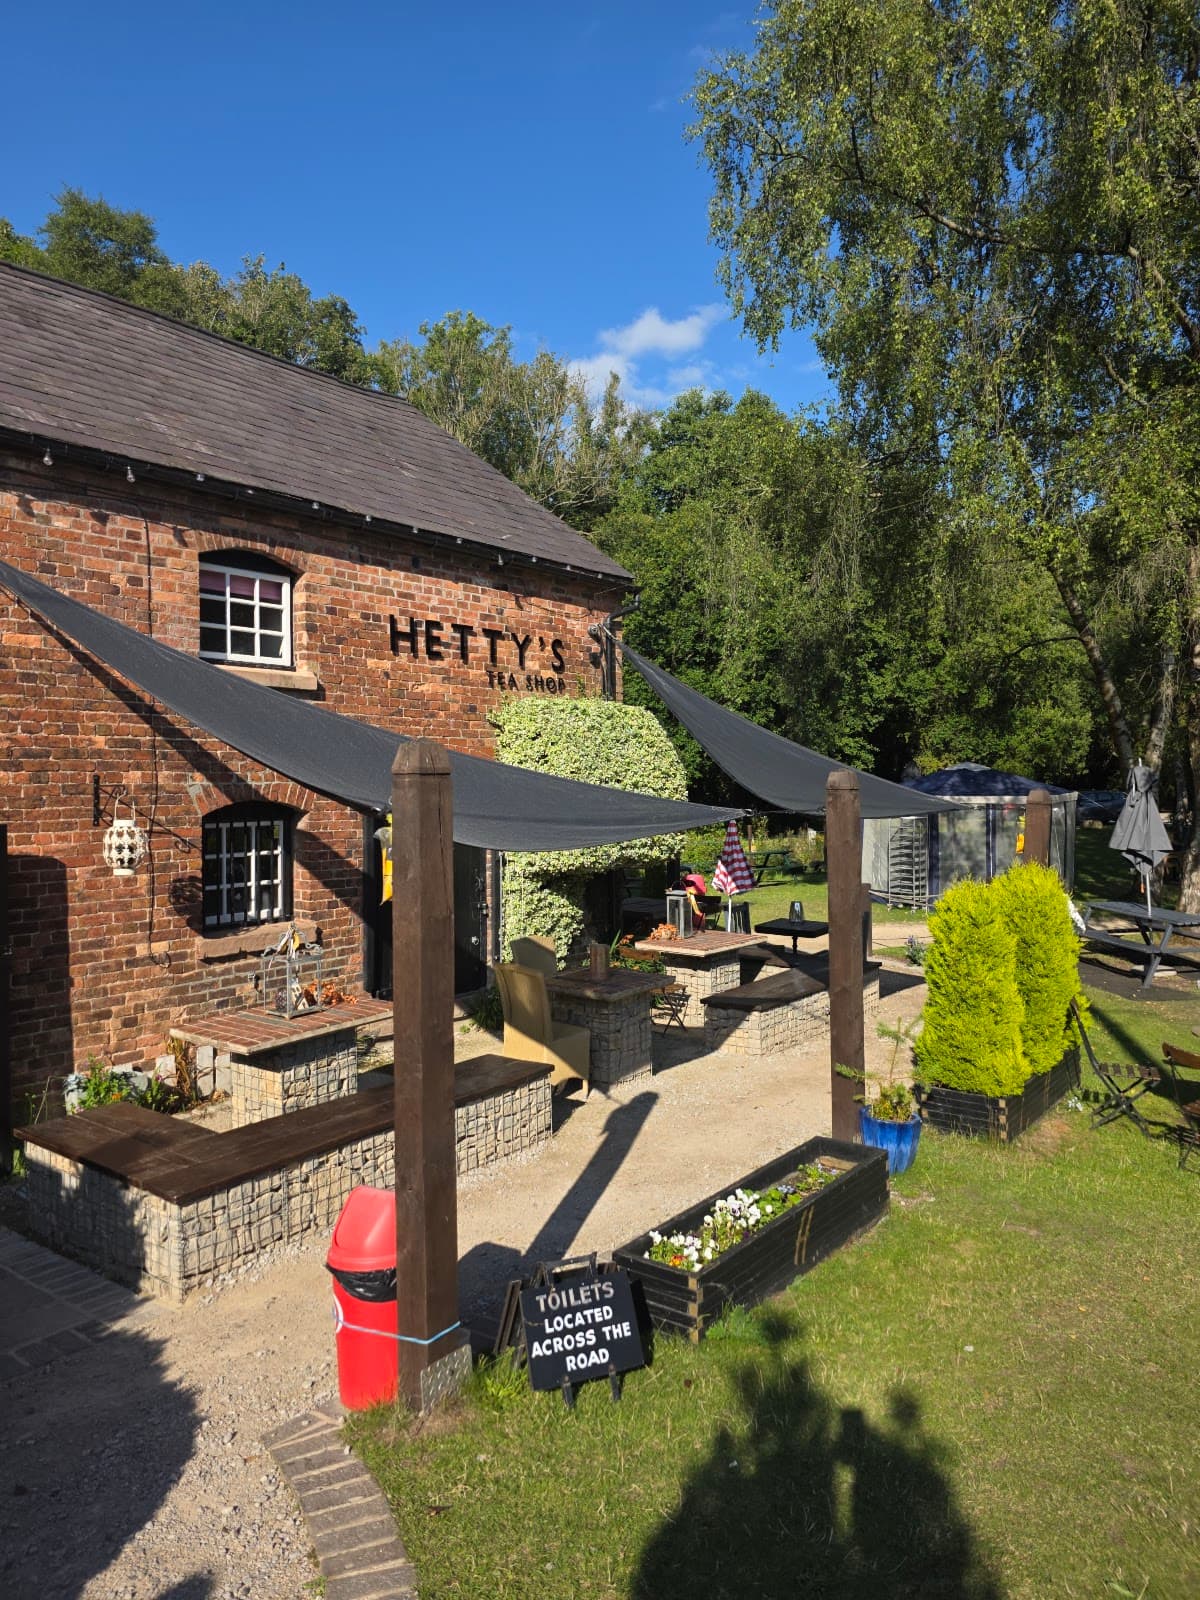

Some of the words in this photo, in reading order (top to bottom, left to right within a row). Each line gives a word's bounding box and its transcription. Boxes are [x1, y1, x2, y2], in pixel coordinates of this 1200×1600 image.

[389, 614, 566, 674] HETTY'S
[486, 670, 519, 690] TEA
[526, 674, 566, 694] SHOP
[536, 1282, 614, 1312] TOILETS
[544, 1305, 613, 1333] LOCATED
[532, 1329, 596, 1358] ACROSS
[603, 1322, 631, 1340] THE
[566, 1348, 609, 1371] ROAD
